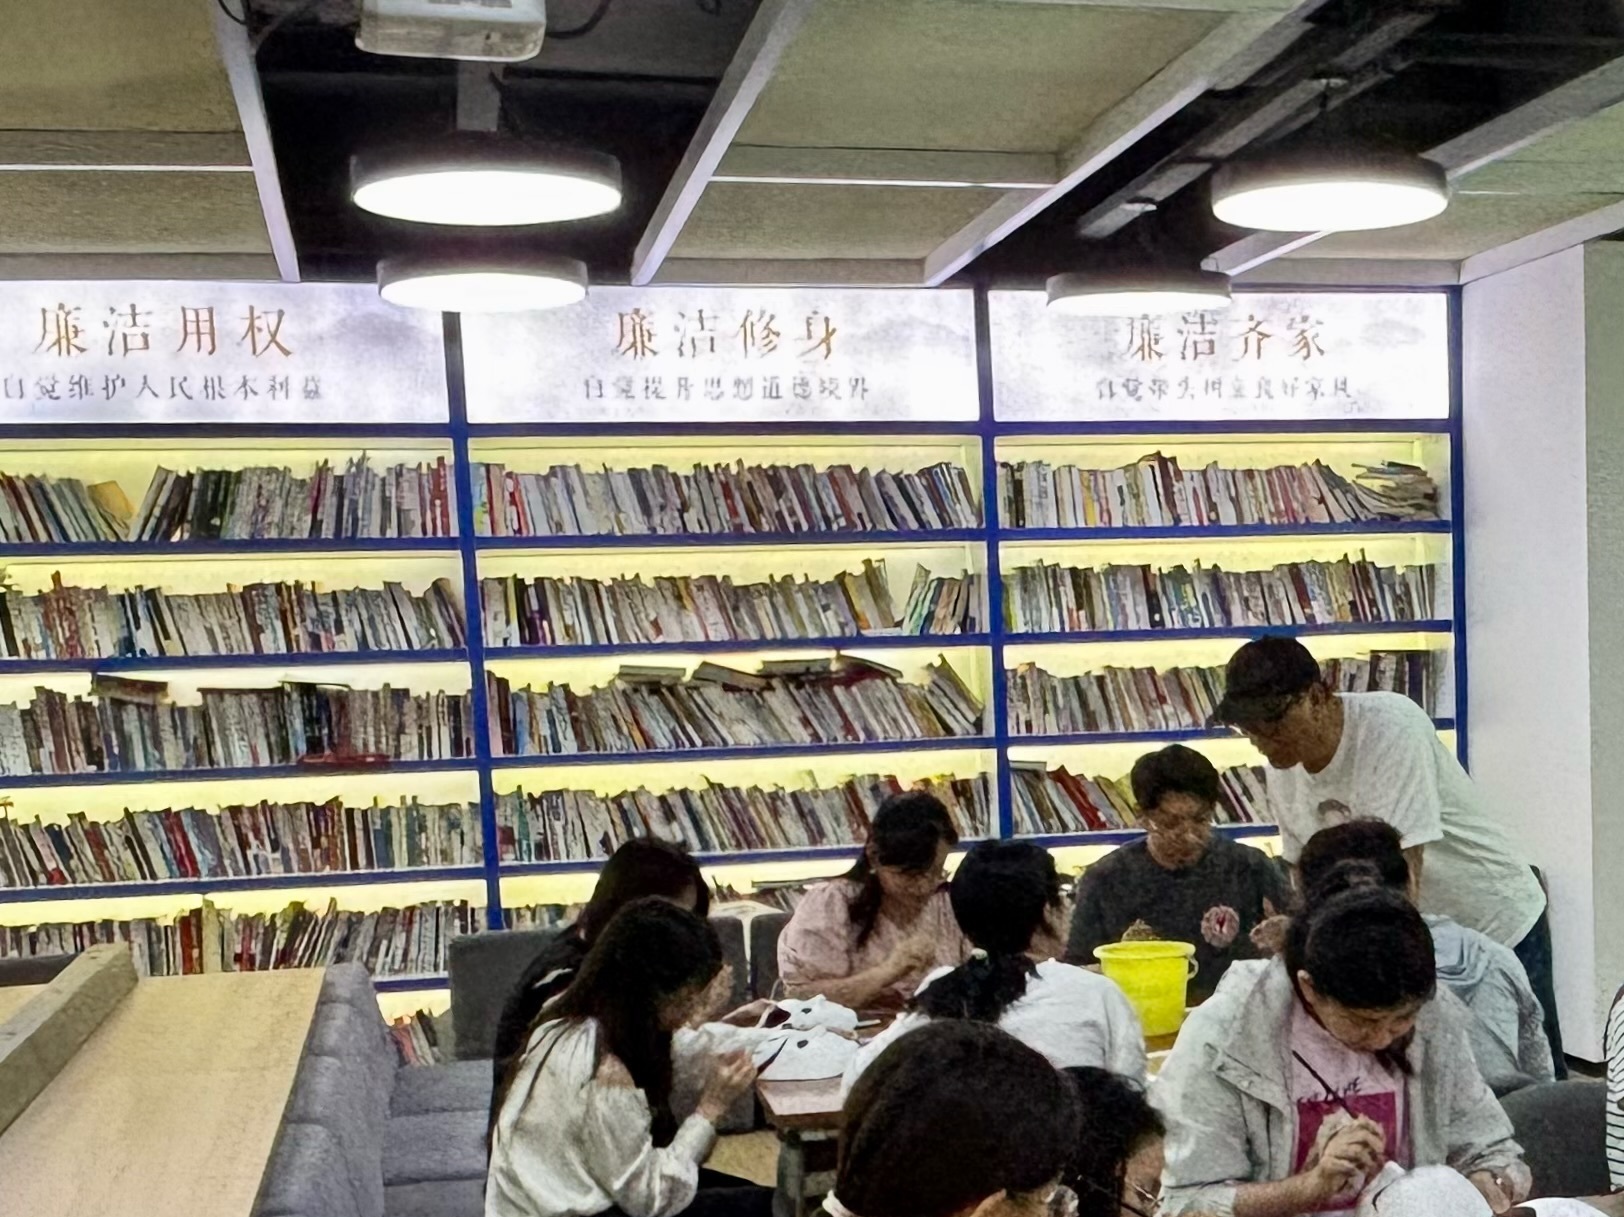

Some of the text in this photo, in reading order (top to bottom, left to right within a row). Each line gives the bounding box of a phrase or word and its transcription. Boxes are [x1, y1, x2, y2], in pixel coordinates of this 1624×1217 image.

[34, 302, 292, 358] 廉洁用权
[612, 307, 837, 363] 廉洁修身
[1128, 313, 1326, 362] 廉洁齐家
